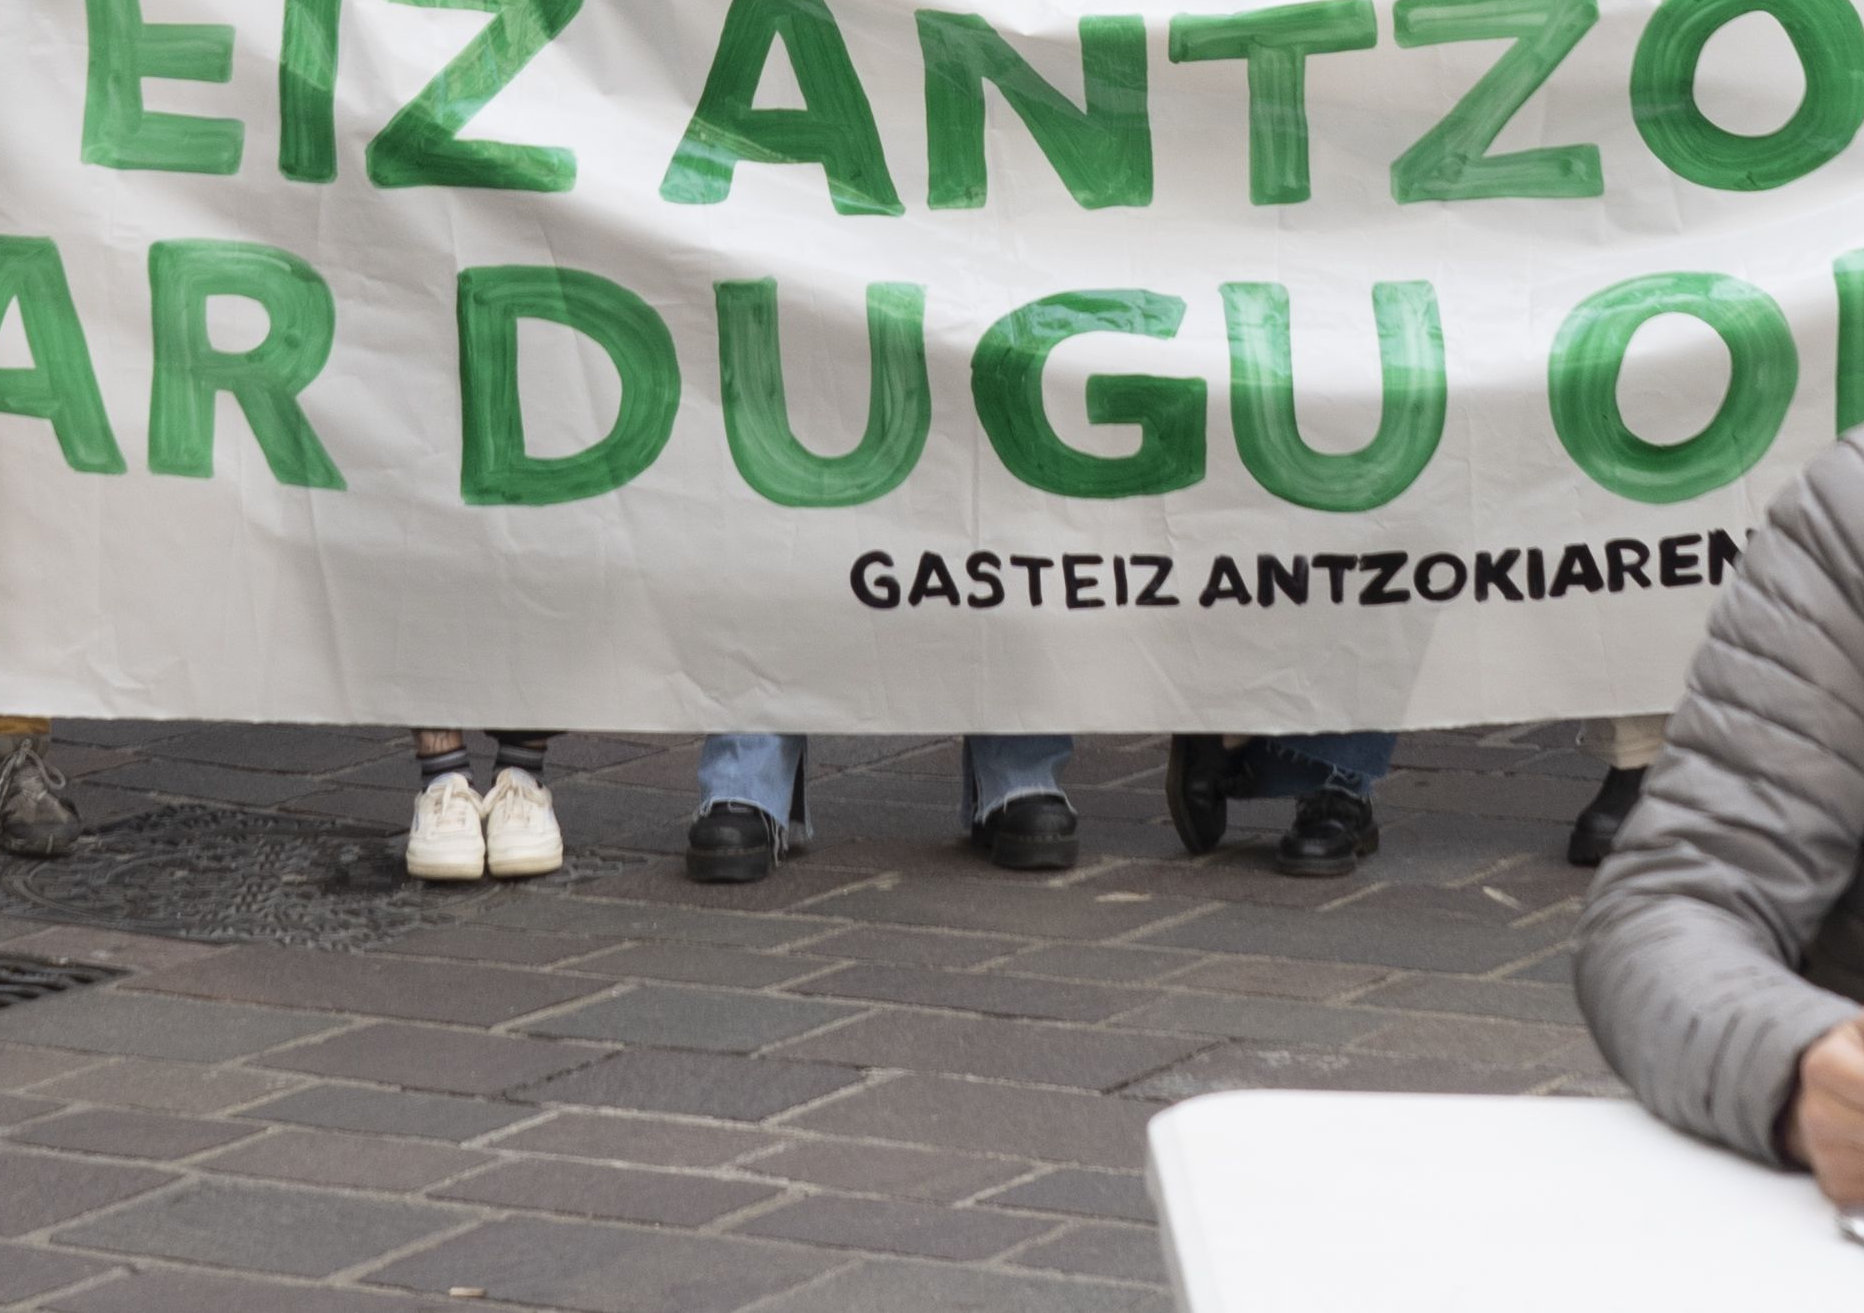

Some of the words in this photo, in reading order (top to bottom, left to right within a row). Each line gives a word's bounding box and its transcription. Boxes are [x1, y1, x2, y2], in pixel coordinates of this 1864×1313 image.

[457, 263, 1448, 514] DUGU
[849, 548, 1181, 613] GASTEIZ
[1198, 527, 1751, 610] ANTZOKIAREN
